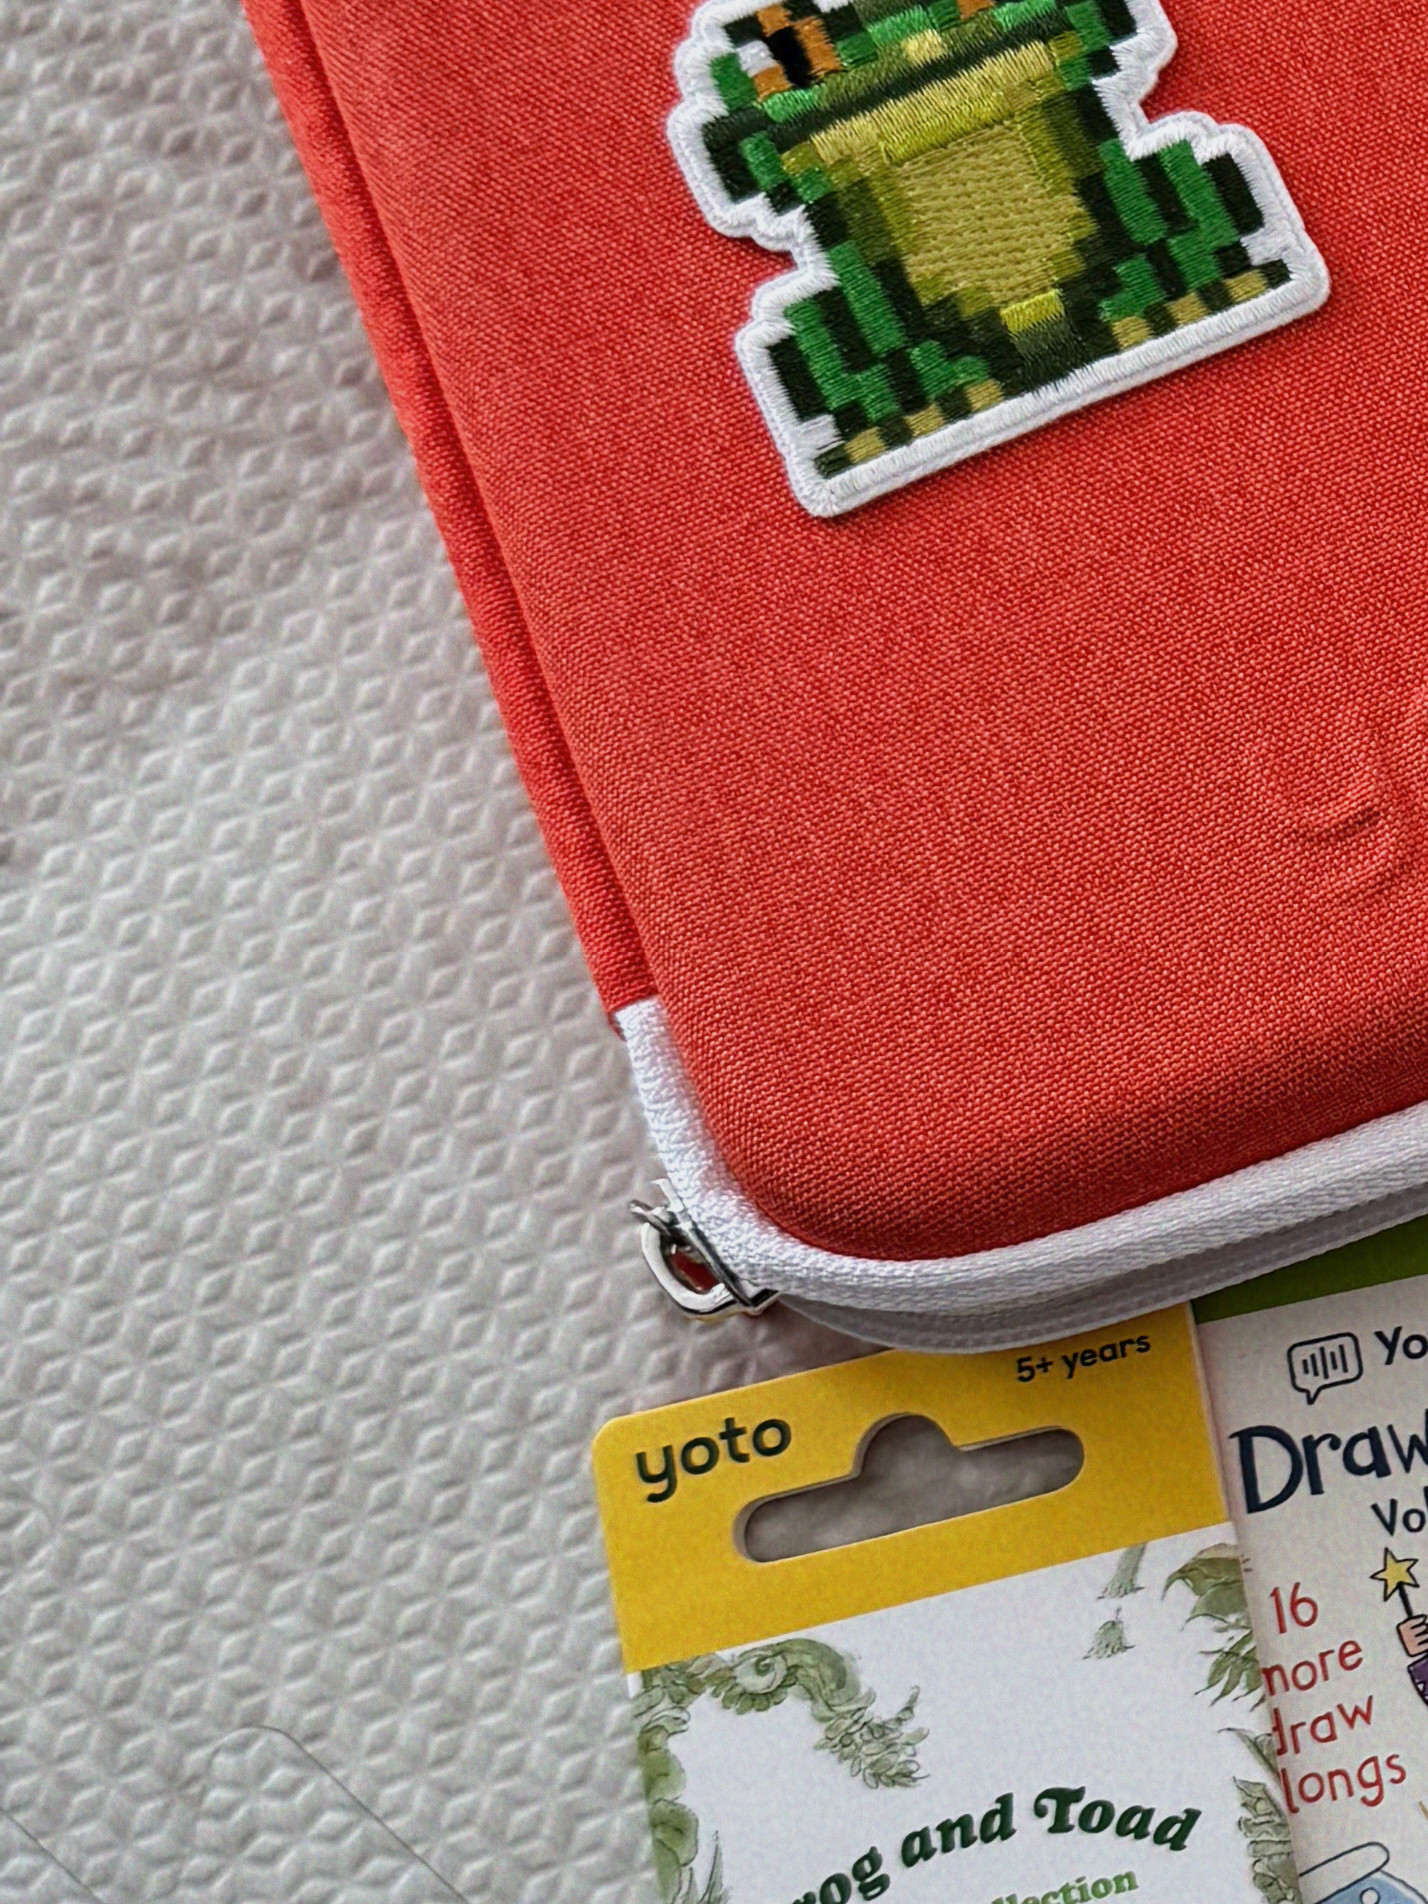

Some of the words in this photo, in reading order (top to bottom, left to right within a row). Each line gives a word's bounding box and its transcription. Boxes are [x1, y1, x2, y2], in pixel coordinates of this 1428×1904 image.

[1015, 1356, 1054, 1383] 5+
[1062, 1332, 1151, 1379] years
[635, 1417, 792, 1503] yoto
[1270, 1582, 1318, 1634] 16
[901, 1793, 1017, 1868] and
[1034, 1786, 1202, 1851] Toad
